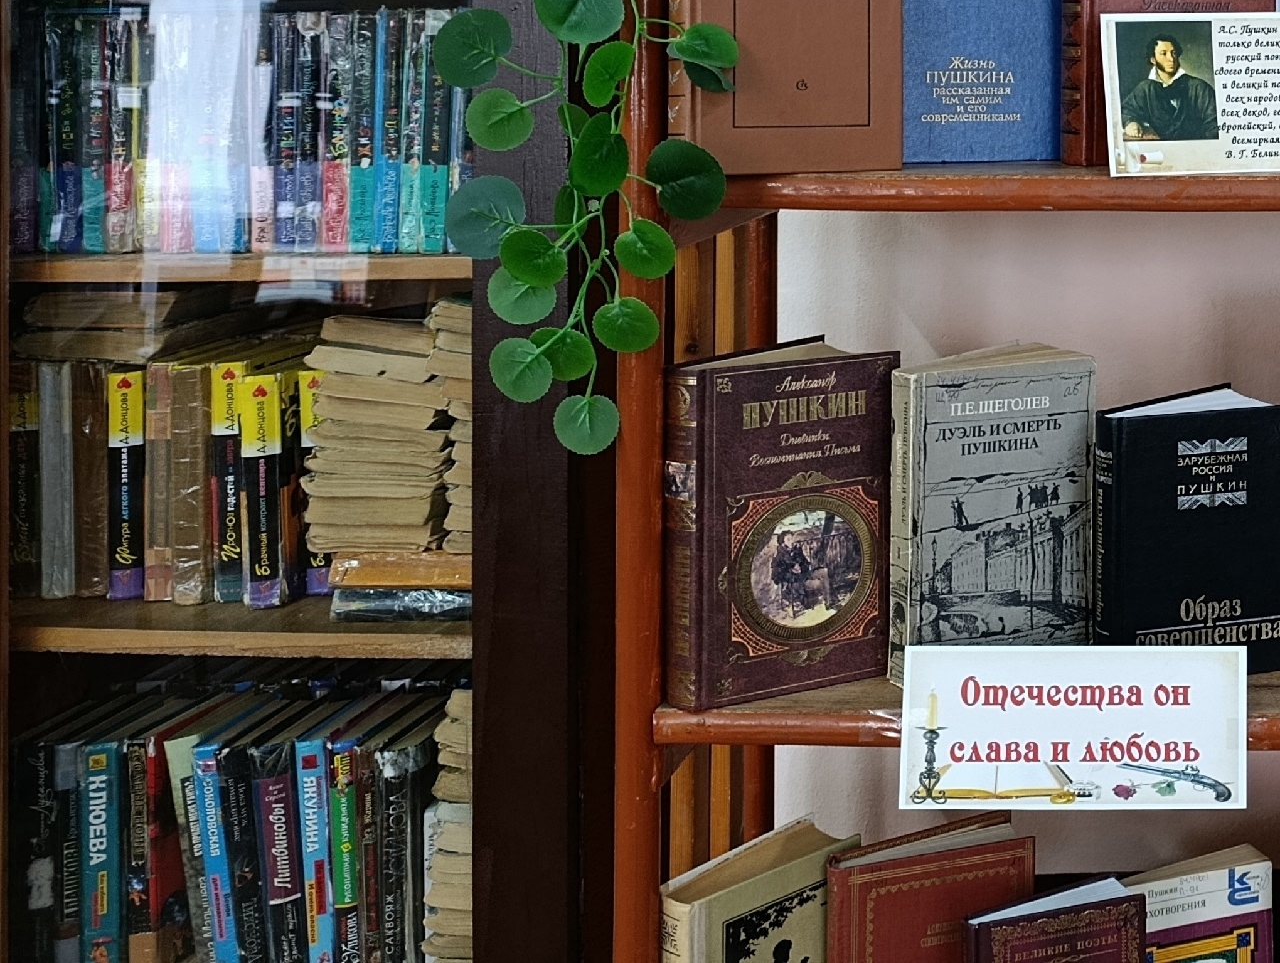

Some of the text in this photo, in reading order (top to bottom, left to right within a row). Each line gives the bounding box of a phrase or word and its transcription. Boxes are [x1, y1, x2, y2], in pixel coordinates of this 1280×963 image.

[1240, 24, 1279, 37] Пушкин
[1218, 39, 1252, 49] только
[948, 56, 996, 70] Жизнь
[1225, 51, 1263, 63] русский
[925, 70, 1016, 85] ПУШКИНА
[1230, 79, 1270, 91] великий
[932, 86, 1012, 97] рассказанная
[942, 96, 1003, 105] им самим
[921, 112, 1022, 124] современниками
[967, 105, 988, 115] его
[775, 370, 837, 393] Александр
[742, 389, 868, 431] ПУШКИН
[935, 418, 1062, 443] ДУЭЛЬ И СМЕРТЬ
[960, 436, 1040, 457] ПУШКИНА
[1177, 452, 1249, 467] ЗАРУБЕЖНАЯ
[1192, 464, 1233, 476] РОССИЯ
[223, 475, 236, 511] гадостей
[1177, 481, 1248, 495] ПУШКИН
[114, 447, 140, 564] Фигура легкого эпатажа
[254, 458, 270, 576] Брачный контракт кентавра
[220, 512, 243, 562] Прогноз
[1179, 594, 1242, 626] Образ
[960, 674, 1192, 711] Отечества он
[949, 732, 1201, 764] слава и любовь
[88, 775, 108, 866] КЛЮЕВА
[202, 778, 222, 857] СОКОЛОВСКАЯ
[303, 776, 320, 853] ЯКУНИНА
[269, 802, 292, 889] Литвиновы
[1147, 886, 1179, 900] Пушкин
[1145, 899, 1207, 919] ХОТВОРЕНИЯ
[384, 893, 396, 955] САКВОЯЖ
[1014, 933, 1119, 962] ВЕЛИКИЕ ПОЭТЫ
